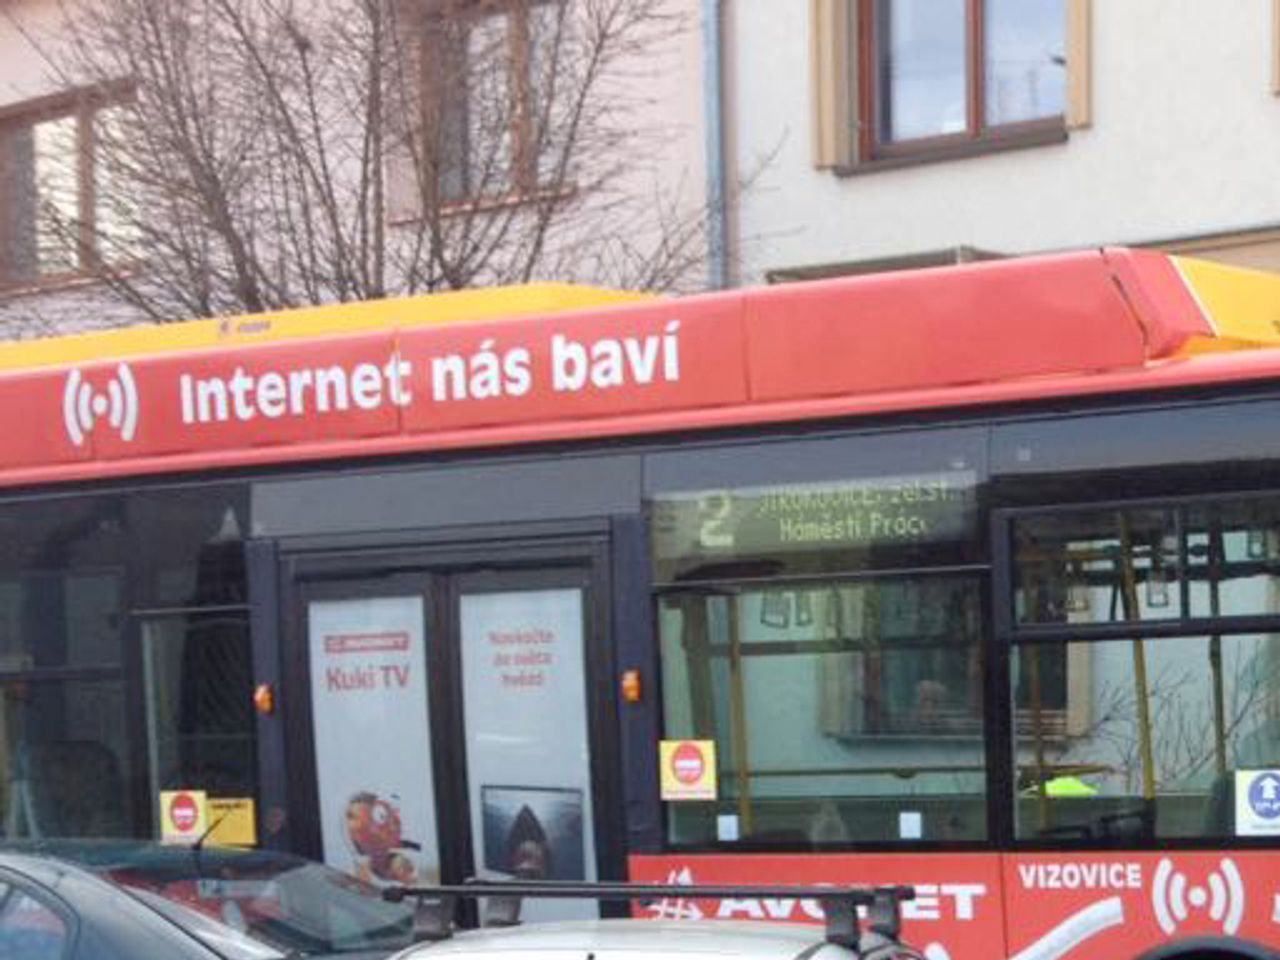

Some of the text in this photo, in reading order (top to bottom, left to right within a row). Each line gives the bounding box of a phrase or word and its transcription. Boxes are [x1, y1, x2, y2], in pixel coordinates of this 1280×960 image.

[180, 320, 680, 424] Internet nás baví
[700, 488, 734, 546] 2
[325, 662, 410, 692] Kuki TV
[1018, 863, 1142, 889] VIZOVICE
